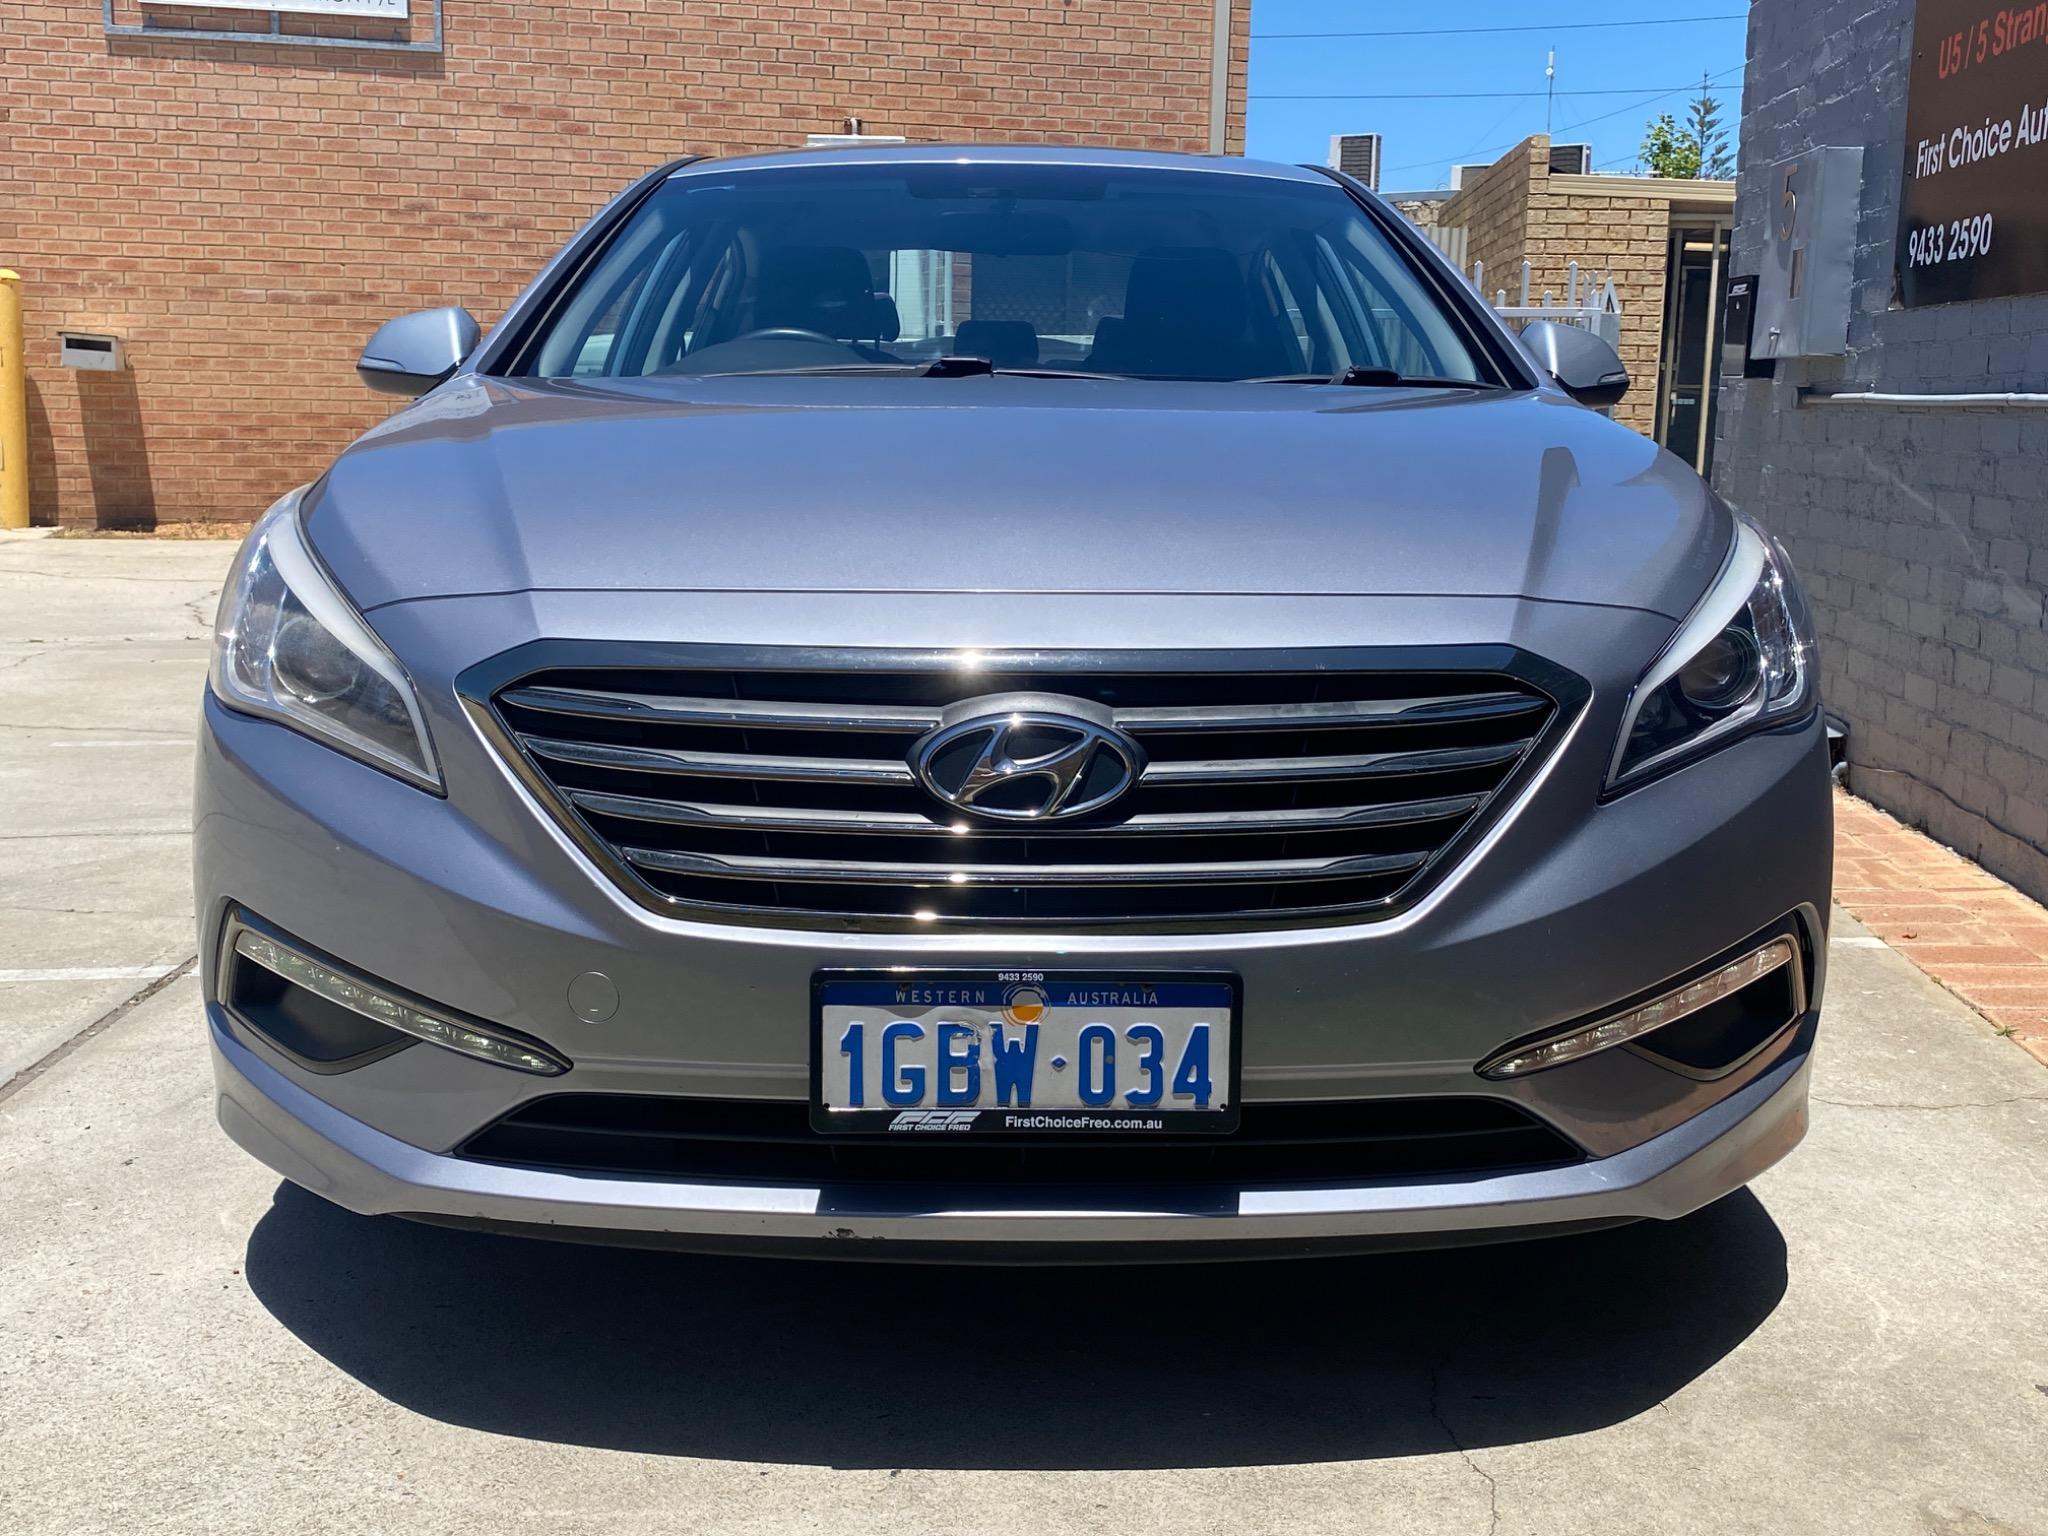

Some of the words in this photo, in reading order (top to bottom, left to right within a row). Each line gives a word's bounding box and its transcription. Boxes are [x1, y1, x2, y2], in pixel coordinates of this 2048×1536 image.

[1939, 32, 1962, 79] U5
[1976, 19, 1989, 63] 5
[1992, 3, 2048, 56] Stran
[1915, 132, 1946, 179] First
[1948, 117, 2012, 168] Choice
[1780, 163, 1798, 241] 5
[1909, 223, 1945, 268] 9433
[1947, 212, 1993, 261] 2590
[895, 989, 985, 1003] WESTERN
[1067, 991, 1159, 1005] AUSTRALIA
[998, 973, 1020, 982] 9433
[1022, 973, 1044, 982] 2590
[1005, 1116, 1163, 1129] FirstChoiceFreo.com.au
